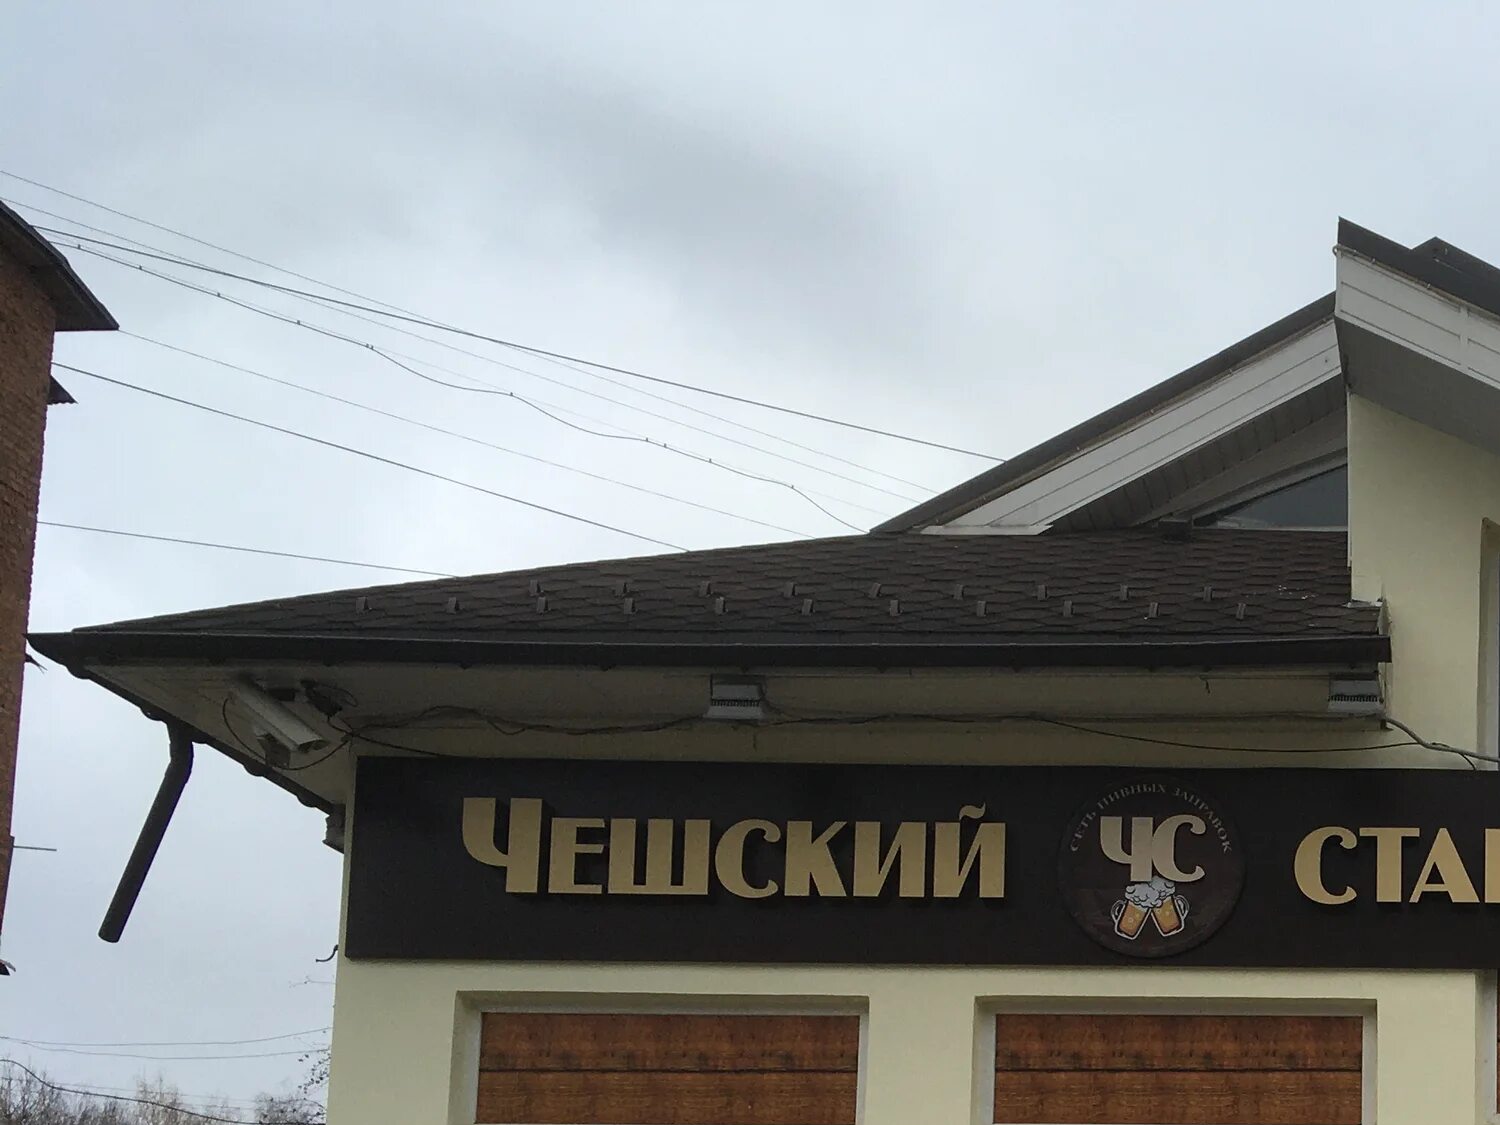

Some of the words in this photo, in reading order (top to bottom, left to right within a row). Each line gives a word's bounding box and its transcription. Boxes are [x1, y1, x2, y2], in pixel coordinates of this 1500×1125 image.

[461, 797, 1006, 900] ЧЕШСКИЙ
[1071, 811, 1097, 852] СЕТЬ
[1097, 783, 1167, 810] ПИВНЫХ
[1174, 787, 1232, 854] ЗАПРАВОК
[1100, 814, 1206, 883] ЧС
